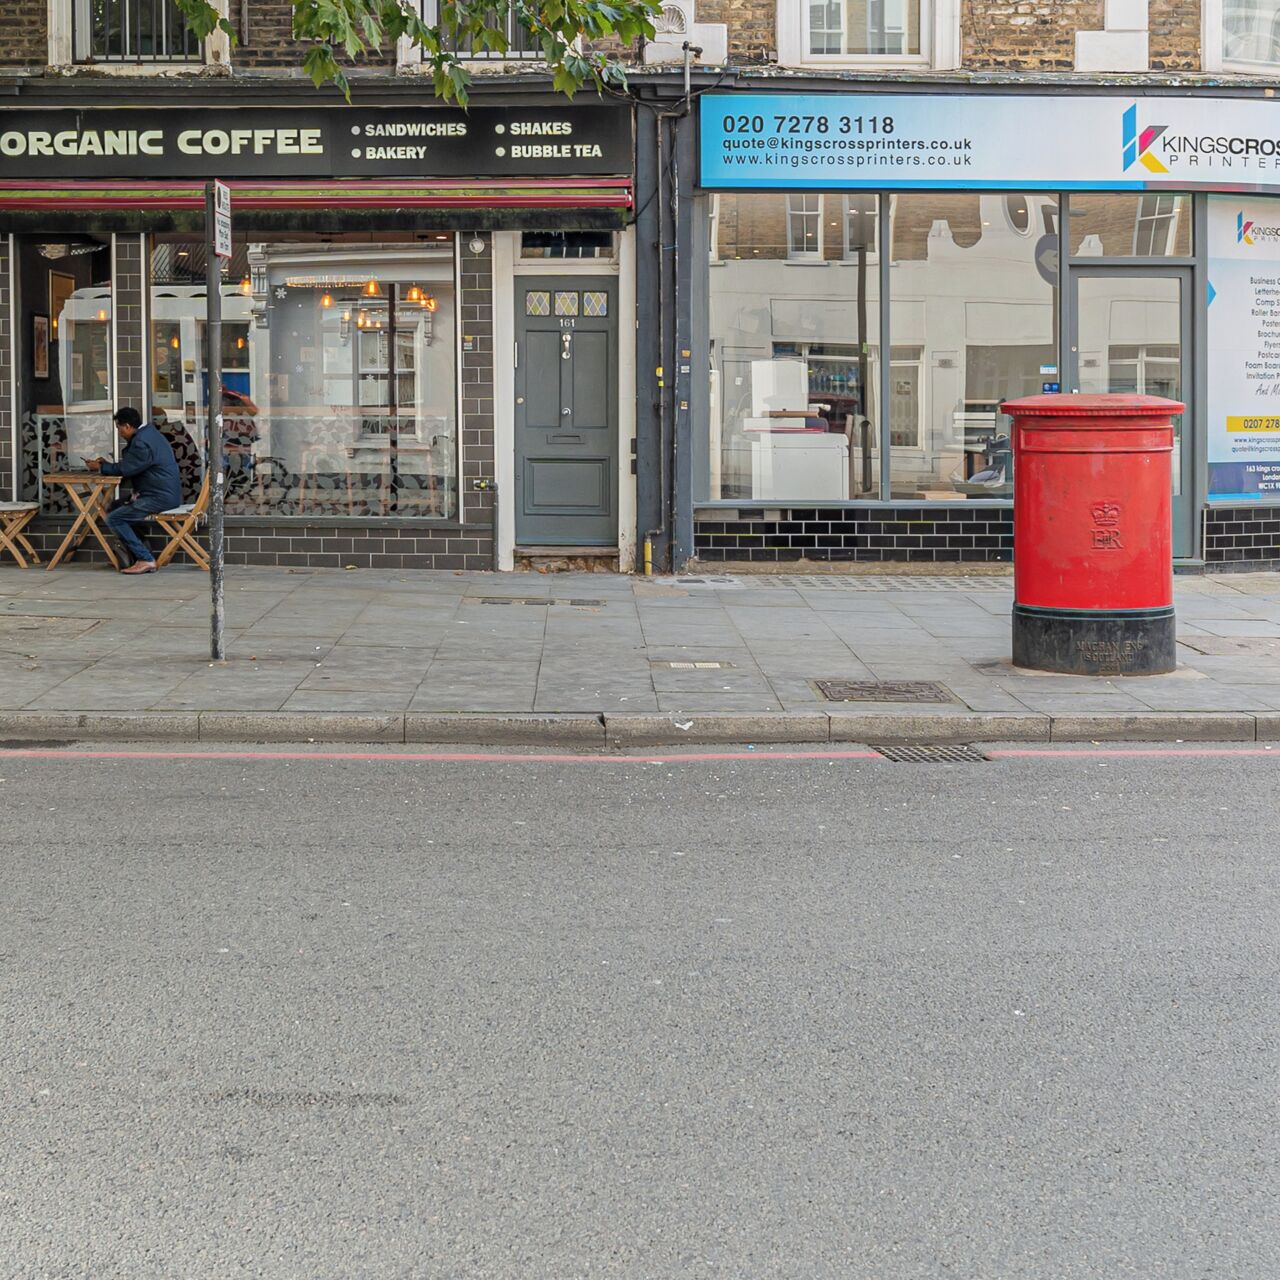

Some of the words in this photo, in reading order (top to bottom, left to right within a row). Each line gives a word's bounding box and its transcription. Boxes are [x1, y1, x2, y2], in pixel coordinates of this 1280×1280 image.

[365, 123, 467, 136] SANDWICHES
[510, 122, 572, 135] SHAKES
[723, 116, 764, 133] 020
[774, 116, 829, 134] 7278
[839, 116, 895, 134] 3118
[0, 130, 164, 156] ORGANIC
[177, 129, 323, 155] COFFEE
[723, 137, 972, 151] quote@kingscrossprinters.co.uk
[365, 146, 427, 159] BAKERY
[511, 145, 572, 158] BUBBLE
[573, 144, 603, 157] TEA
[723, 153, 972, 168] www.kingscrossprinters.co.uk
[1250, 277, 1276, 285] Business
[1255, 298, 1275, 307] Comp
[1251, 309, 1268, 317] Roller
[560, 319, 575, 327] 161
[1245, 361, 1263, 369] Foam
[1246, 372, 1275, 380] Invitation
[1255, 384, 1269, 395] And
[1243, 419, 1263, 429] 0207
[1265, 419, 1280, 429] 278
[1256, 465, 1271, 473] kings
